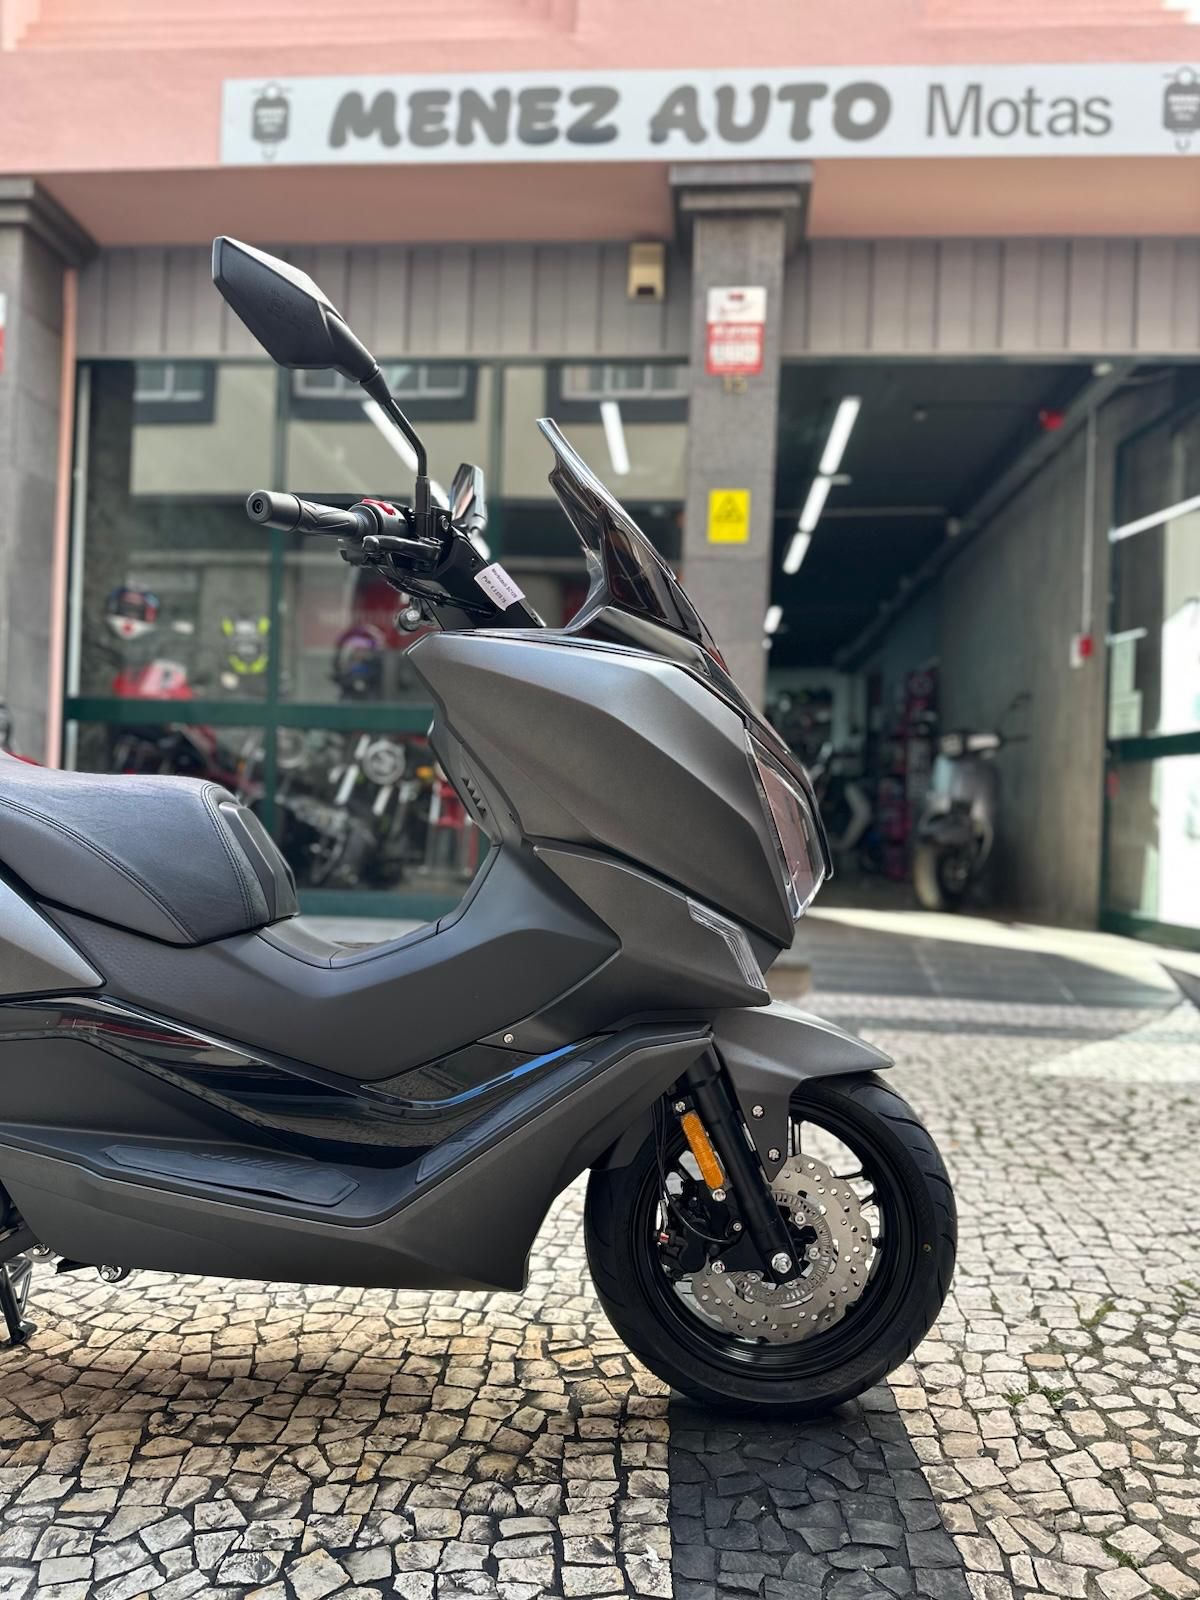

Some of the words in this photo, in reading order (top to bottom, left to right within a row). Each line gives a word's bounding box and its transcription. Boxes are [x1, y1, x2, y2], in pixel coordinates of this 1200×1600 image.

[328, 85, 621, 149] MENEZ
[648, 81, 893, 146] AUTO
[926, 82, 1113, 138] Motas
